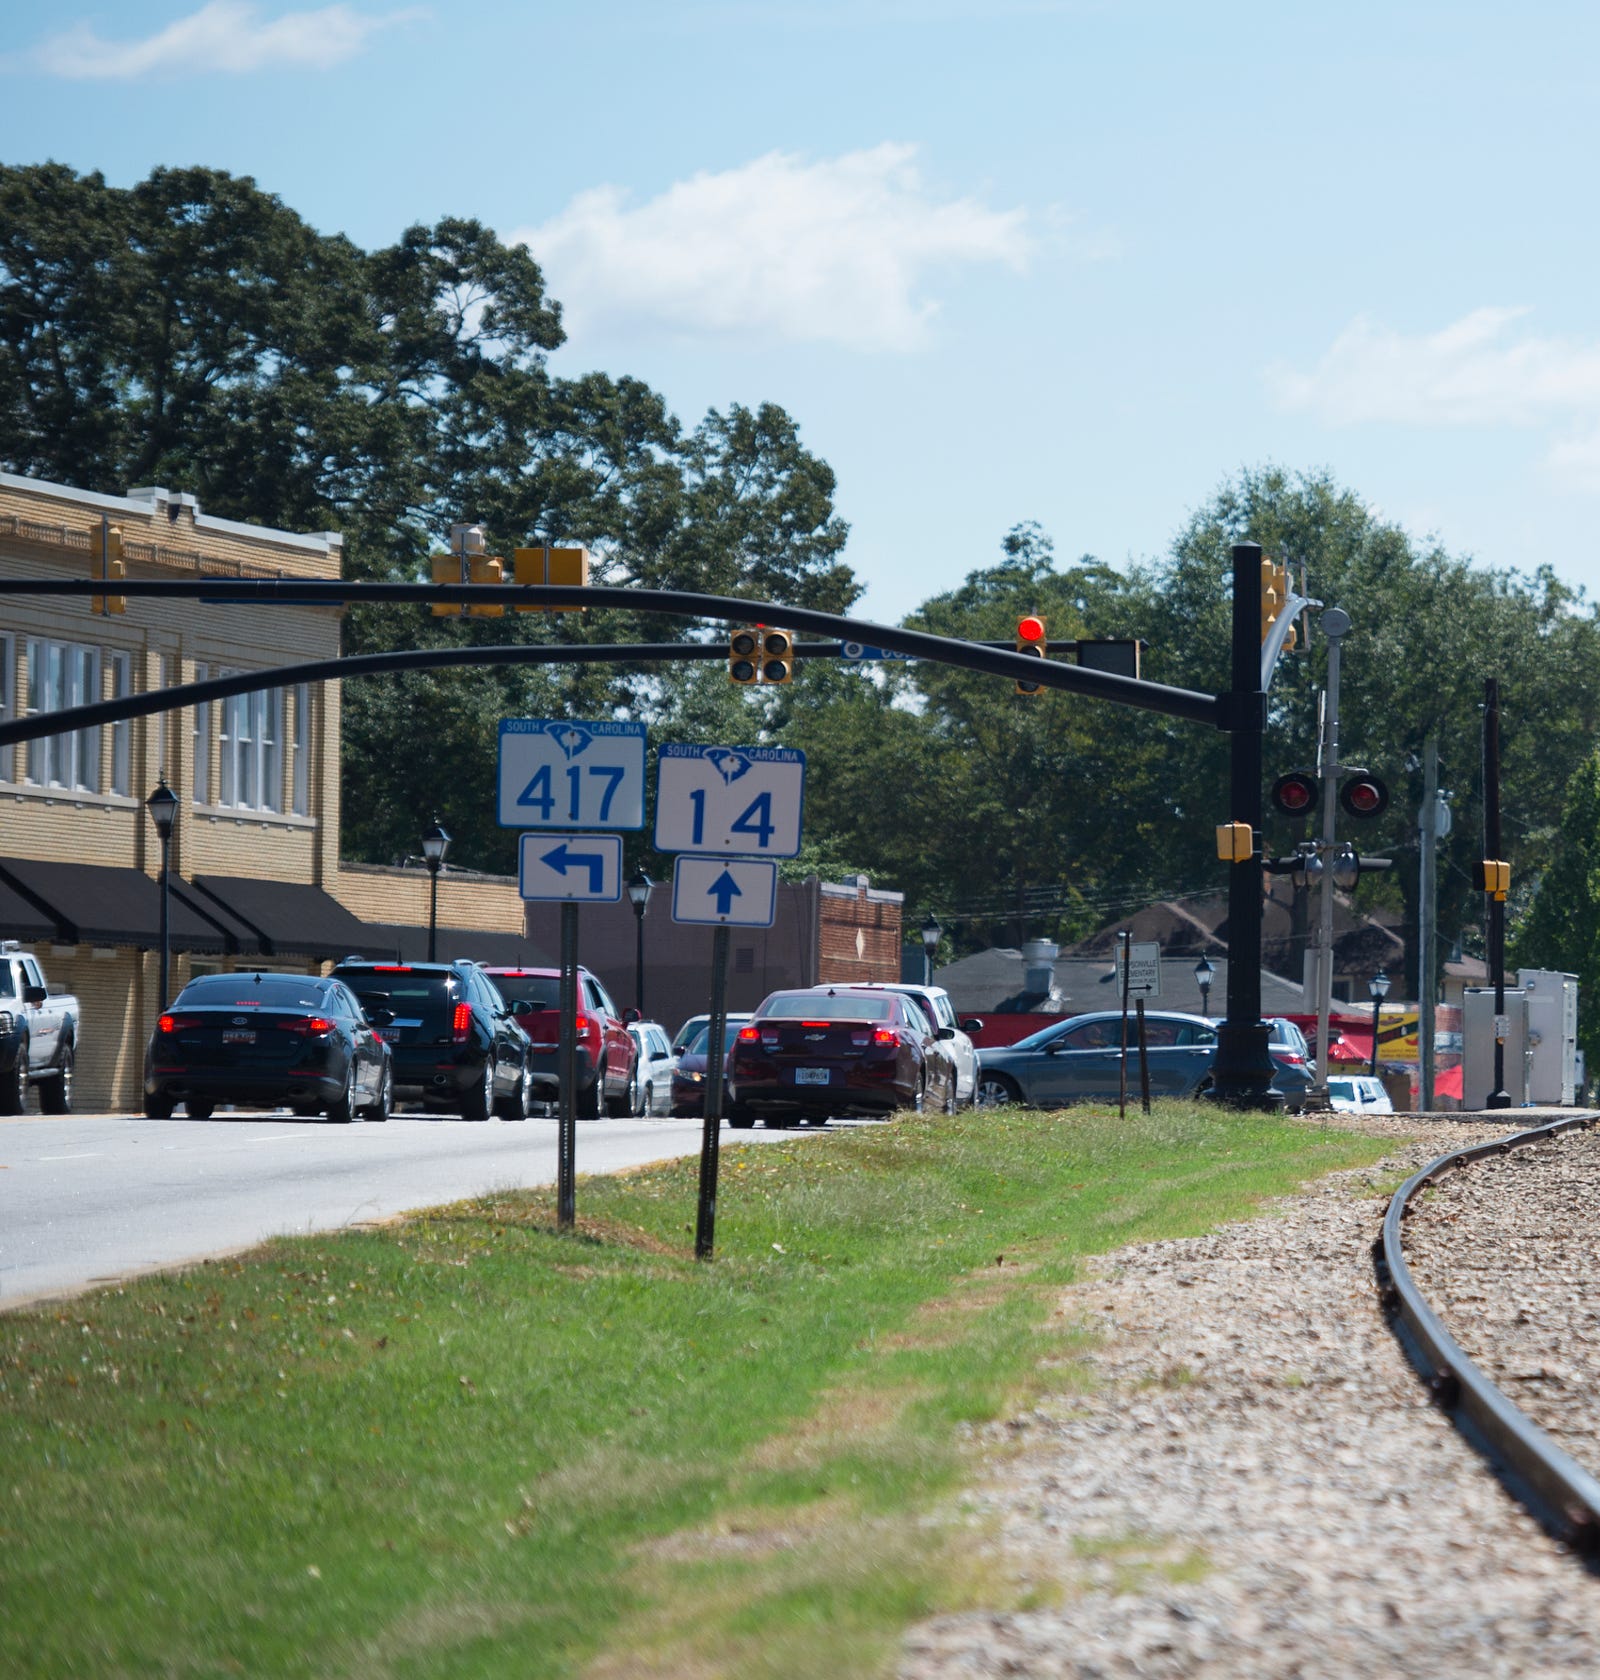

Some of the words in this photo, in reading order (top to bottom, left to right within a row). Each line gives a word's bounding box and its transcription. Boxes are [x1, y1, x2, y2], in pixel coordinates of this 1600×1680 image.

[506, 721, 540, 733] SOUTH
[591, 723, 641, 736] CAROLINA
[666, 745, 700, 757] SOUTH
[749, 749, 798, 762] CAROLINA
[516, 764, 625, 821] 417
[689, 788, 776, 848] 14
